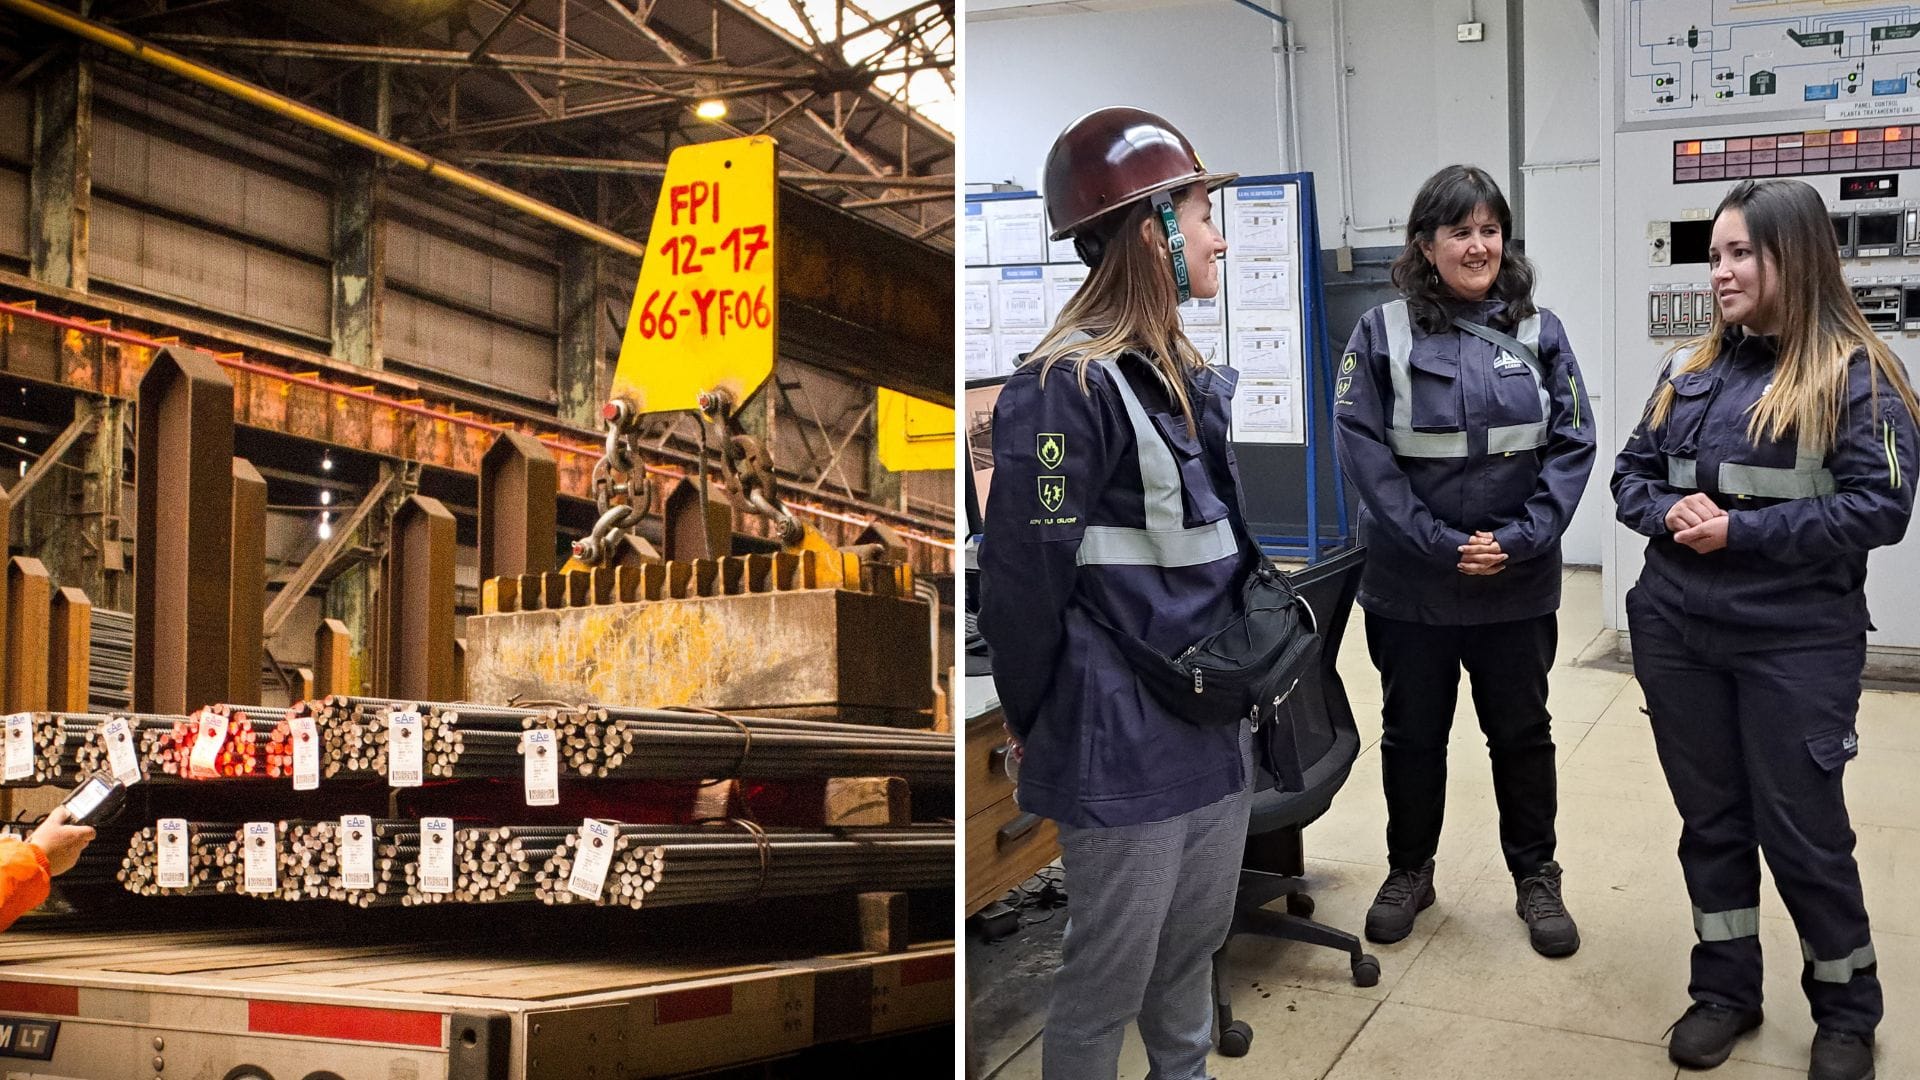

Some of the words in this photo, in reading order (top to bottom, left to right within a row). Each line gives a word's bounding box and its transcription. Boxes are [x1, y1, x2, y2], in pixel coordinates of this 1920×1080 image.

[670, 181, 719, 226] FPI
[660, 224, 769, 276] 12-17
[1173, 253, 1188, 286] MSA
[395, 713, 415, 724] CAP
[530, 732, 549, 743] CAP
[163, 820, 181, 831] CAP
[347, 817, 365, 828] CAP
[427, 819, 446, 830] CAP
[250, 824, 268, 834] CAP
[590, 824, 609, 837] CAP
[20, 1029, 46, 1048] LT
